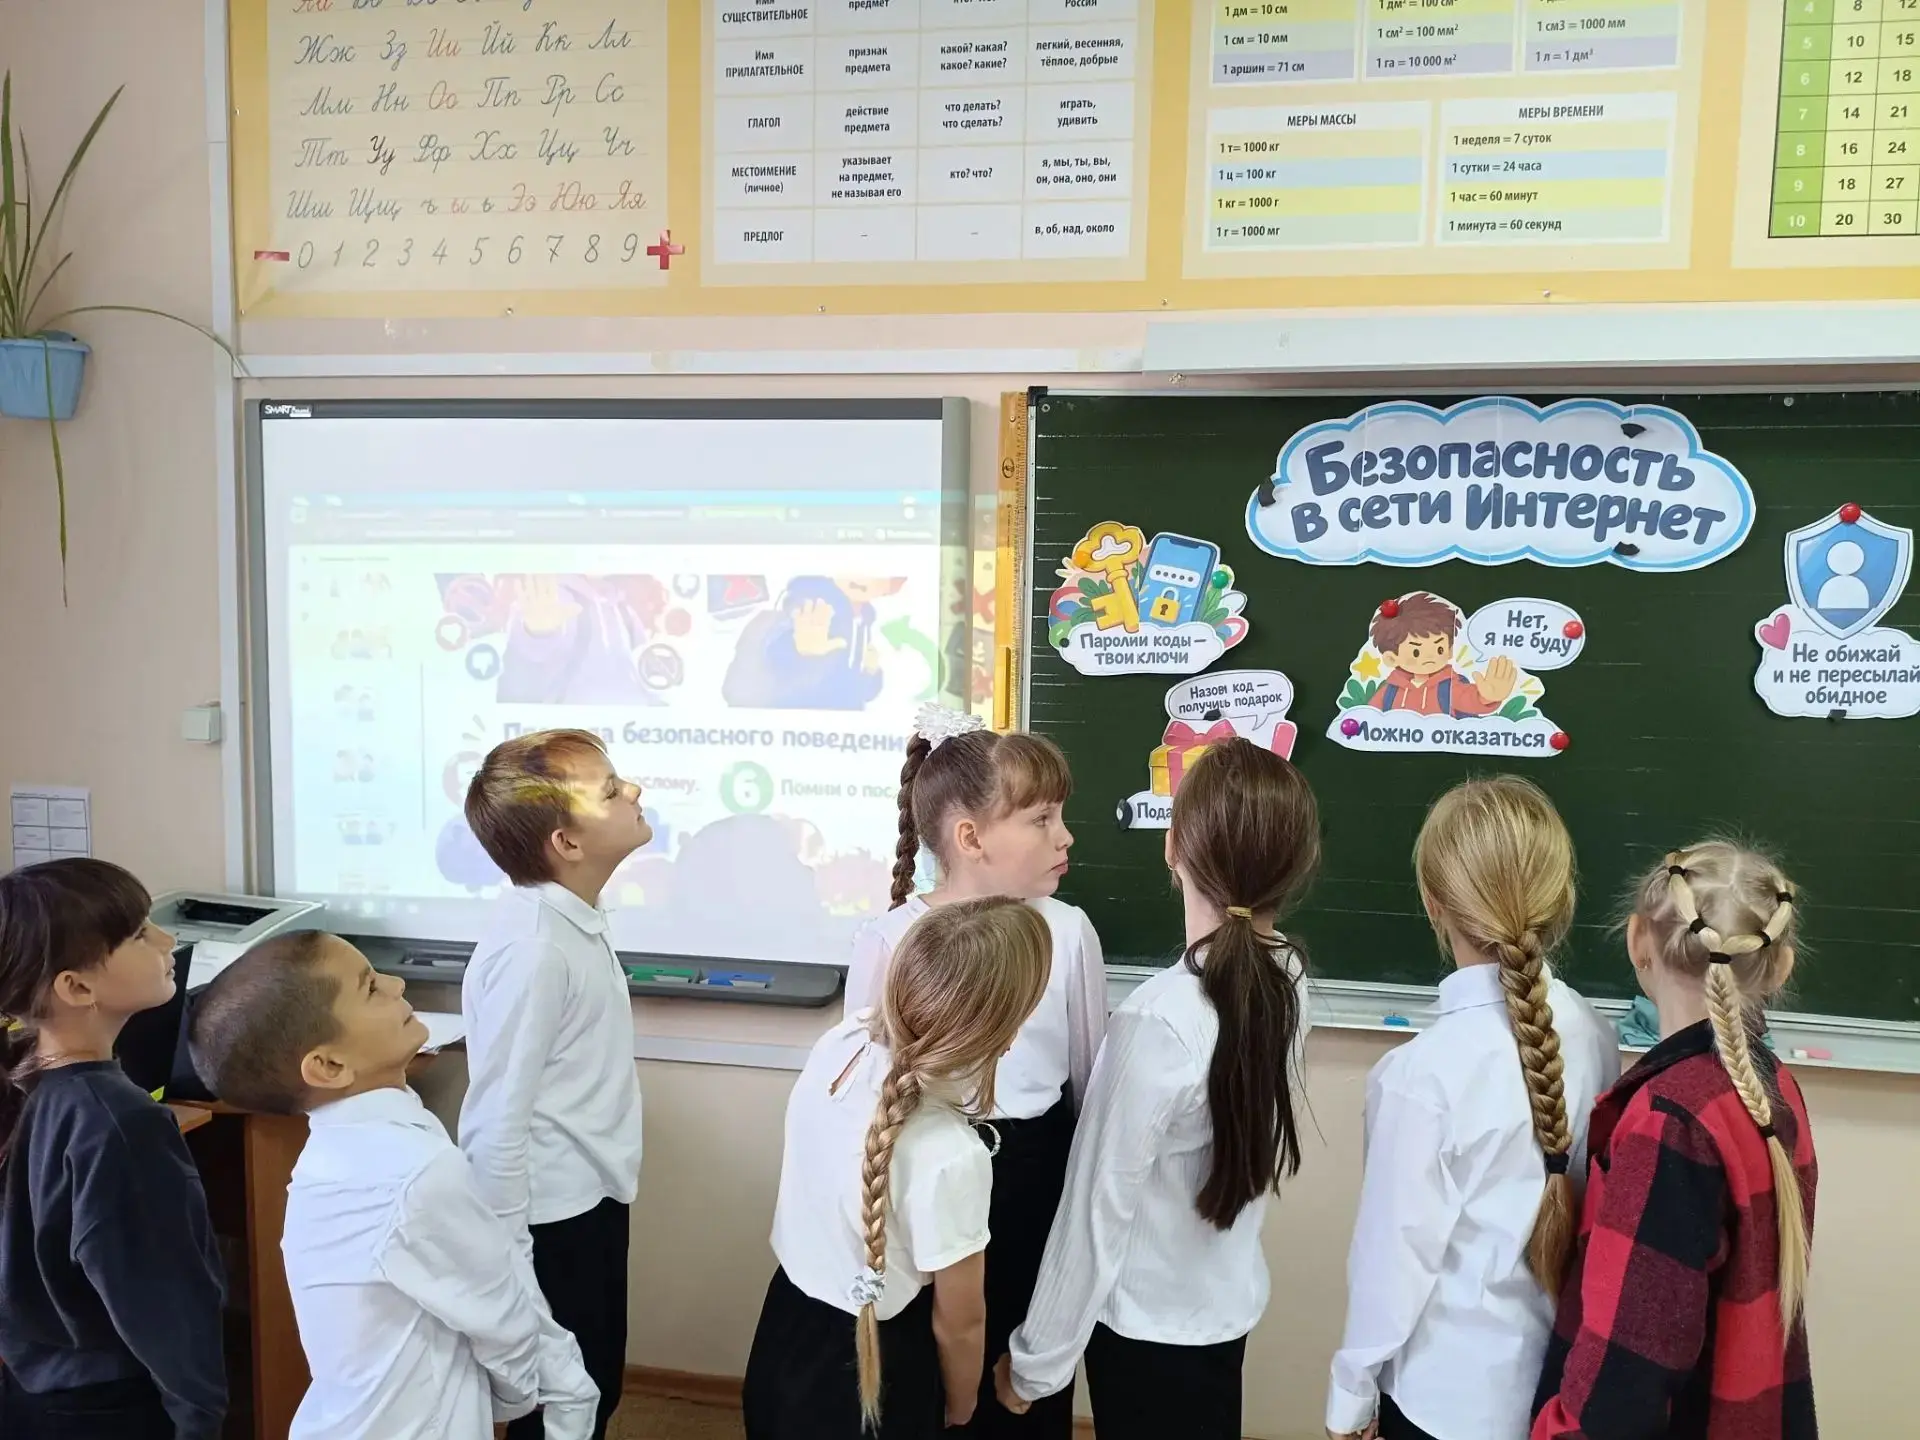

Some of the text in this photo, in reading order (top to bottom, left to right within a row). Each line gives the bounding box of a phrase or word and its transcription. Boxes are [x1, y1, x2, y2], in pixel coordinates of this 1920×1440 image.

[1233, 8, 1247, 18] дм
[1262, 4, 1272, 14] 10
[1853, 0, 1862, 10] 8
[723, 9, 807, 23] СУЩЕСТВИТЕЛЬНОЕ
[1546, 18, 1625, 31] см3 1000 мм
[1417, 26, 1434, 36] 100
[1036, 39, 1123, 50] легкий, весенняя,
[1232, 34, 1287, 45] см 10 мм
[1848, 33, 1914, 47] 10 15
[294, 34, 356, 64] Жж
[379, 30, 408, 71] Зз
[482, 21, 515, 55] Йй
[536, 21, 570, 52] Кк
[941, 41, 1007, 54] какой? какая?
[756, 51, 774, 60] Имя
[849, 48, 887, 59] признак
[941, 58, 1006, 70] какое? какие?
[1041, 54, 1118, 67] тёплое, добрые
[1409, 56, 1420, 66] 10
[1423, 56, 1441, 66] 000
[726, 65, 803, 77] ПРИЛАГАТЕЛЬНОЕ
[846, 64, 890, 75] предмета
[1231, 65, 1264, 76] аршин
[1278, 62, 1288, 72] 71
[1845, 70, 1911, 83] 12 18
[372, 84, 409, 112] Нн
[477, 77, 522, 108] Пп
[541, 74, 576, 117] Рр
[595, 73, 624, 103] Сс
[846, 106, 888, 117] действие
[963, 100, 1000, 112] делать?
[1060, 100, 1096, 111] играть,
[1519, 105, 1603, 118] МЕРЫ ВРЕМЕНИ
[1843, 106, 1907, 118] 14 21
[749, 117, 780, 128] ГЛАГОЛ
[961, 116, 1002, 129] сделать?
[1058, 117, 1097, 127] удивить
[1288, 114, 1356, 126] МЕРЫ МАССЫ
[845, 124, 889, 134] предмета
[1462, 135, 1551, 146] неделя суток
[367, 135, 396, 175] Уу
[413, 134, 451, 173] Фф
[469, 130, 518, 162] Хх
[538, 130, 577, 161] Цц
[604, 126, 635, 155] Чч
[1244, 142, 1267, 152] 1000
[1841, 142, 1906, 154] 16 24
[843, 157, 891, 168] указывает
[1054, 158, 1110, 167] мы, ты, вы,
[1461, 161, 1541, 175] сутки 24 часа
[732, 166, 796, 176] МЕСТОИМЕНИЕ
[950, 168, 992, 178] кто? что?
[1247, 169, 1263, 179] 100
[852, 173, 893, 183] предмет,
[1036, 174, 1116, 185] он, она, оно, они
[1839, 178, 1904, 190] 18 27
[745, 182, 783, 194] (личное)
[845, 189, 884, 197] называя
[287, 180, 647, 223] Шш Щщ Юю Яя
[1249, 197, 1272, 207] 1000
[1490, 191, 1502, 201] 60
[1505, 192, 1538, 203] минут
[1835, 213, 1901, 225] 20 30
[1046, 224, 1114, 234] об, над, около
[1242, 226, 1265, 236] 1000
[1458, 219, 1561, 233] минута 60 секунд
[744, 231, 783, 243] ПРЕДЛОГ
[298, 233, 638, 269] 0 1 2 3 4 5 6 7 8 9
[1305, 440, 1696, 496] Безопасность
[1291, 483, 1726, 545] в сети Интернет
[1508, 610, 1548, 631] Нет,
[1154, 636, 1191, 648] коды
[1484, 632, 1572, 657] я не буду
[1095, 651, 1189, 666] твои ключи
[1793, 643, 1900, 662] Не обижай
[1774, 665, 1920, 688] и не пересылай
[1232, 681, 1254, 693] код
[1234, 693, 1283, 708] подарок
[1806, 686, 1888, 706] обидное
[623, 722, 773, 746] безопасного
